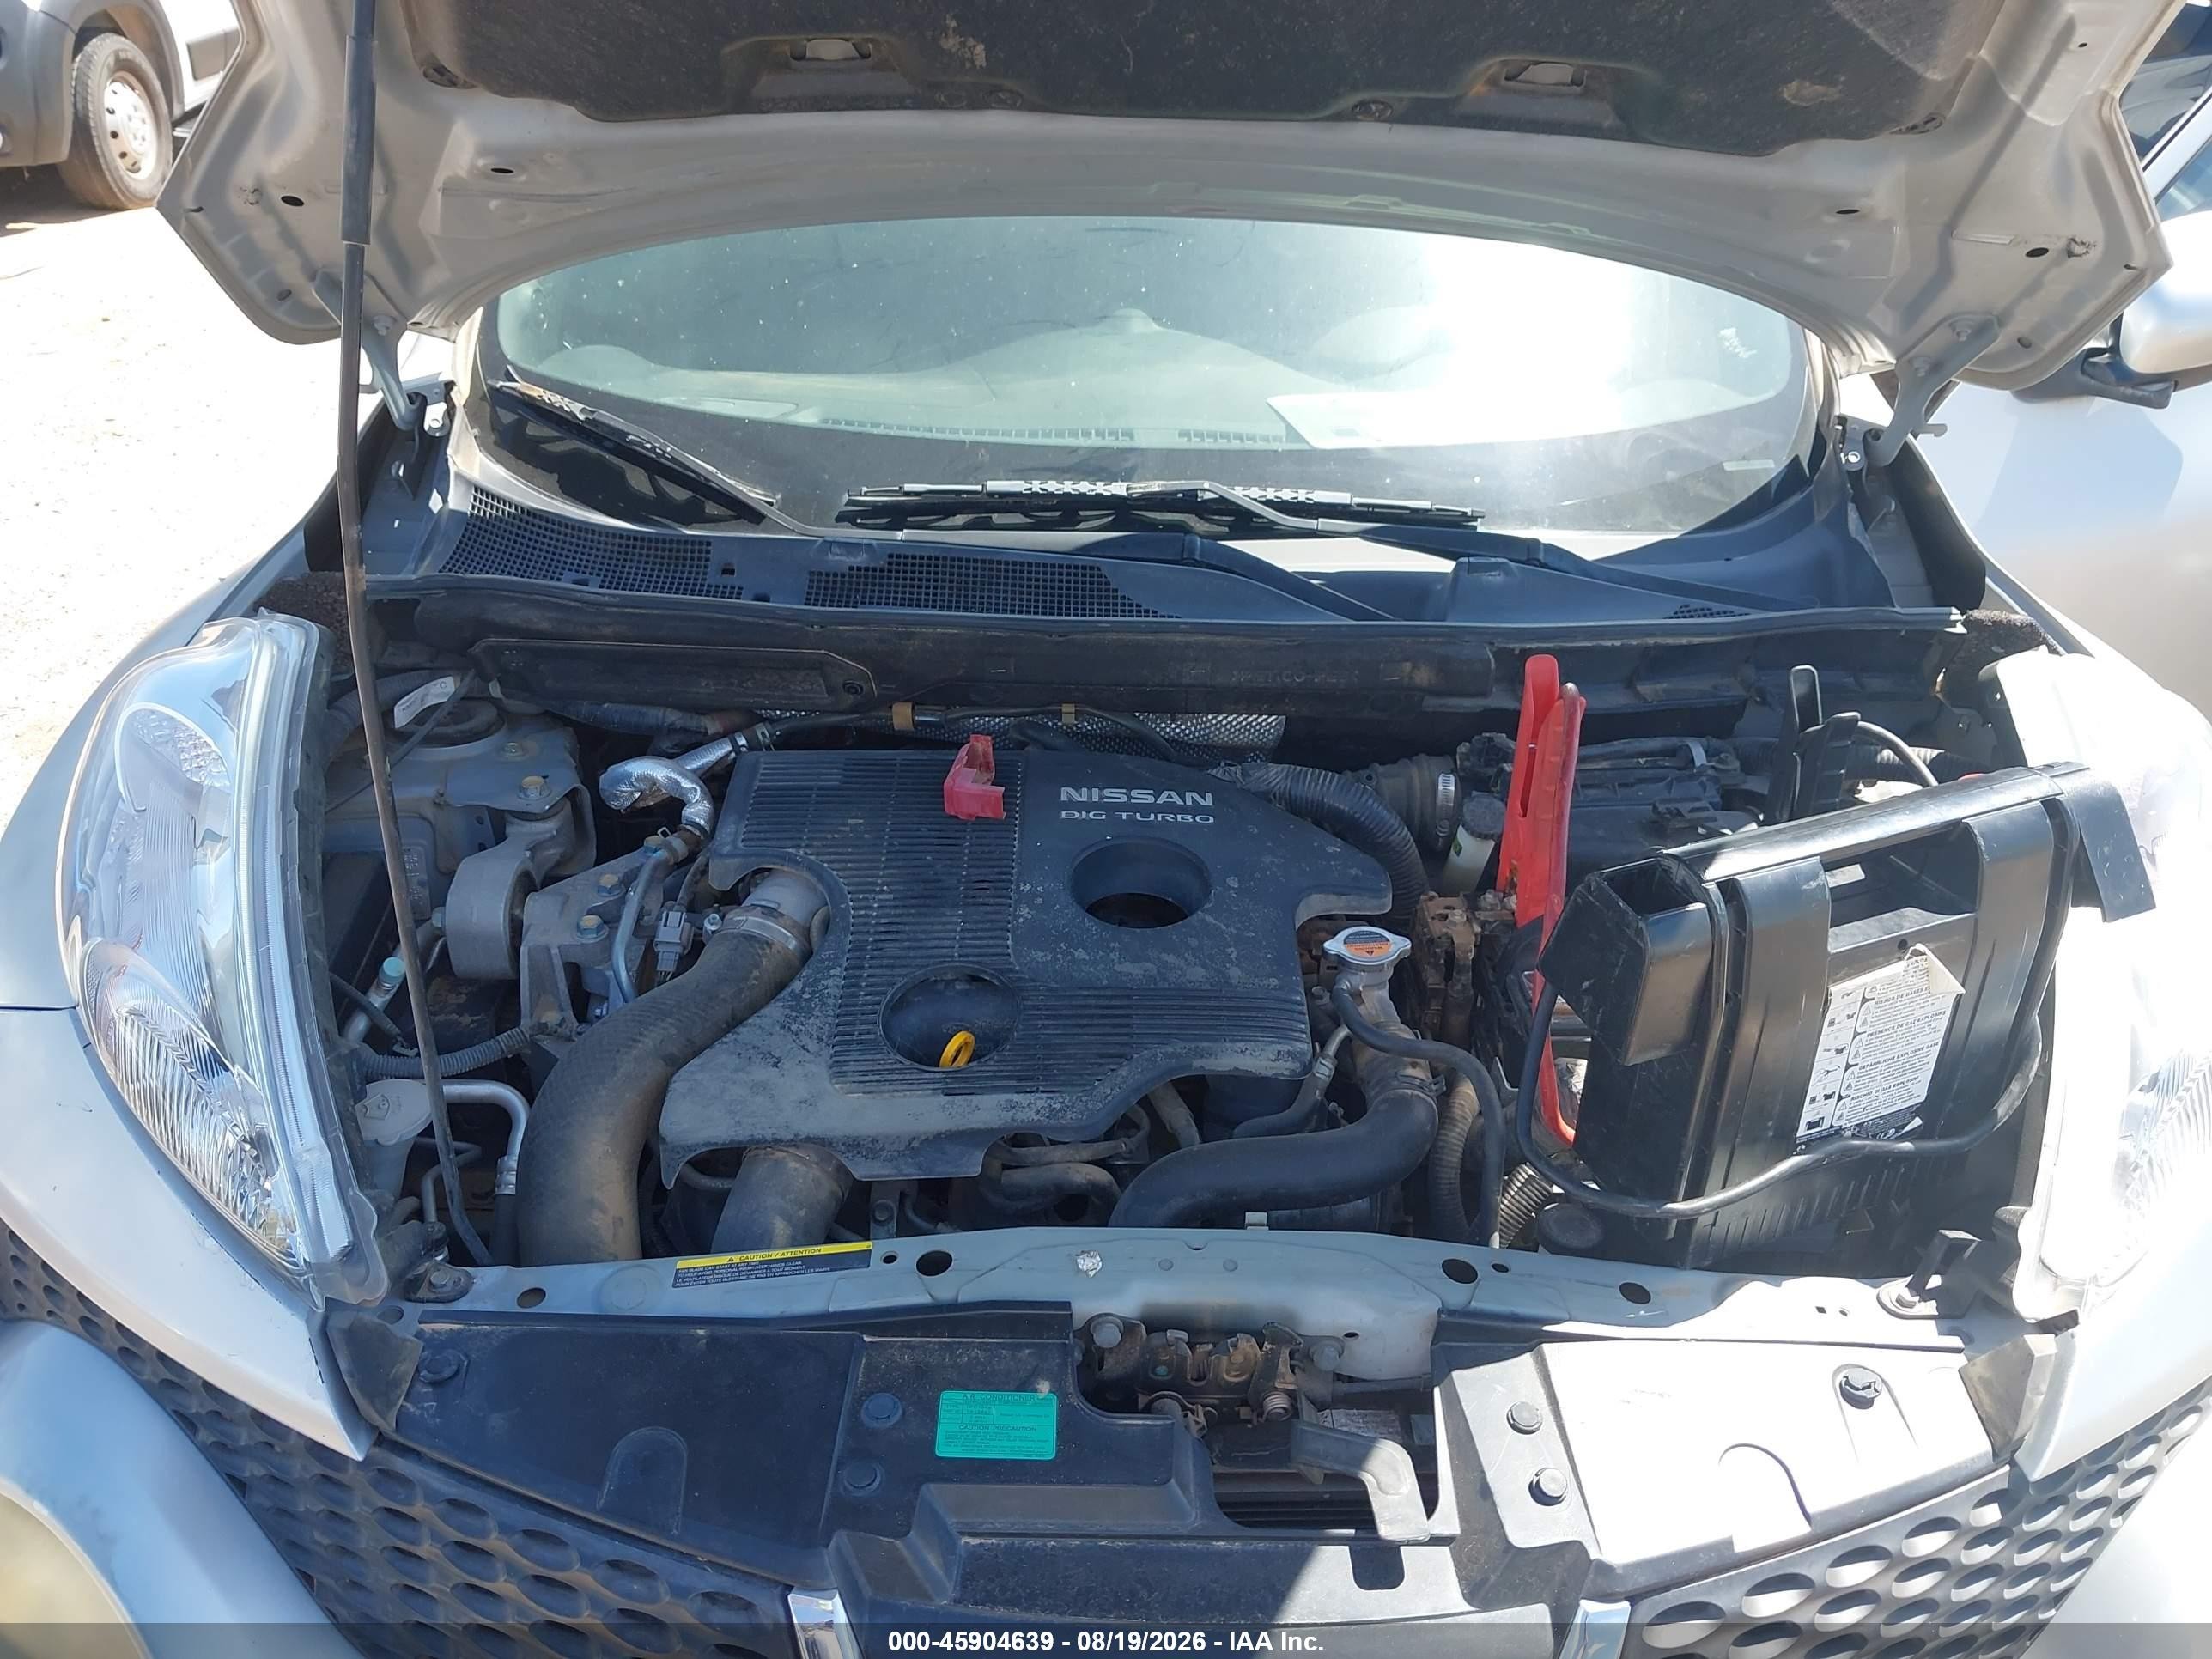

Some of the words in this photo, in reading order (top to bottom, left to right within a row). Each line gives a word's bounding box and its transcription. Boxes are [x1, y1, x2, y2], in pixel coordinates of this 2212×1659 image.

[1060, 787, 1213, 805] NISSAN
[1060, 811, 1106, 819] DIG
[1115, 811, 1214, 823] TURBO
